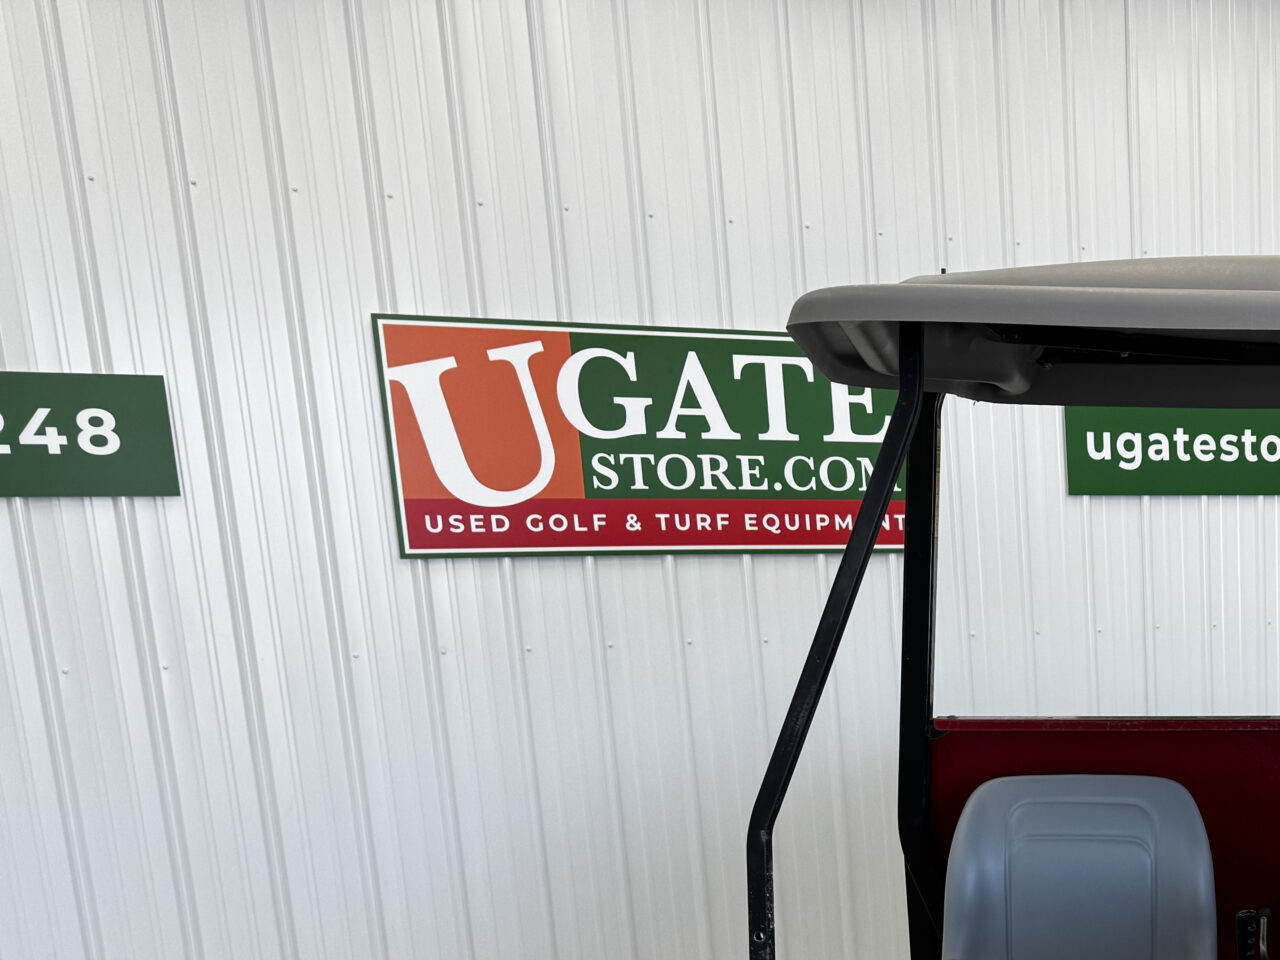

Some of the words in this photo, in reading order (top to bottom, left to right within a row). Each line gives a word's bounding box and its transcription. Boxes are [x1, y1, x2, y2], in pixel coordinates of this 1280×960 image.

[0, 407, 121, 456] 48
[387, 340, 892, 508] UGATE
[424, 513, 510, 534] USED
[525, 513, 607, 533] GOLF
[625, 513, 642, 532] &
[655, 513, 730, 532] TURF
[744, 513, 906, 535] EQUIPMNT
